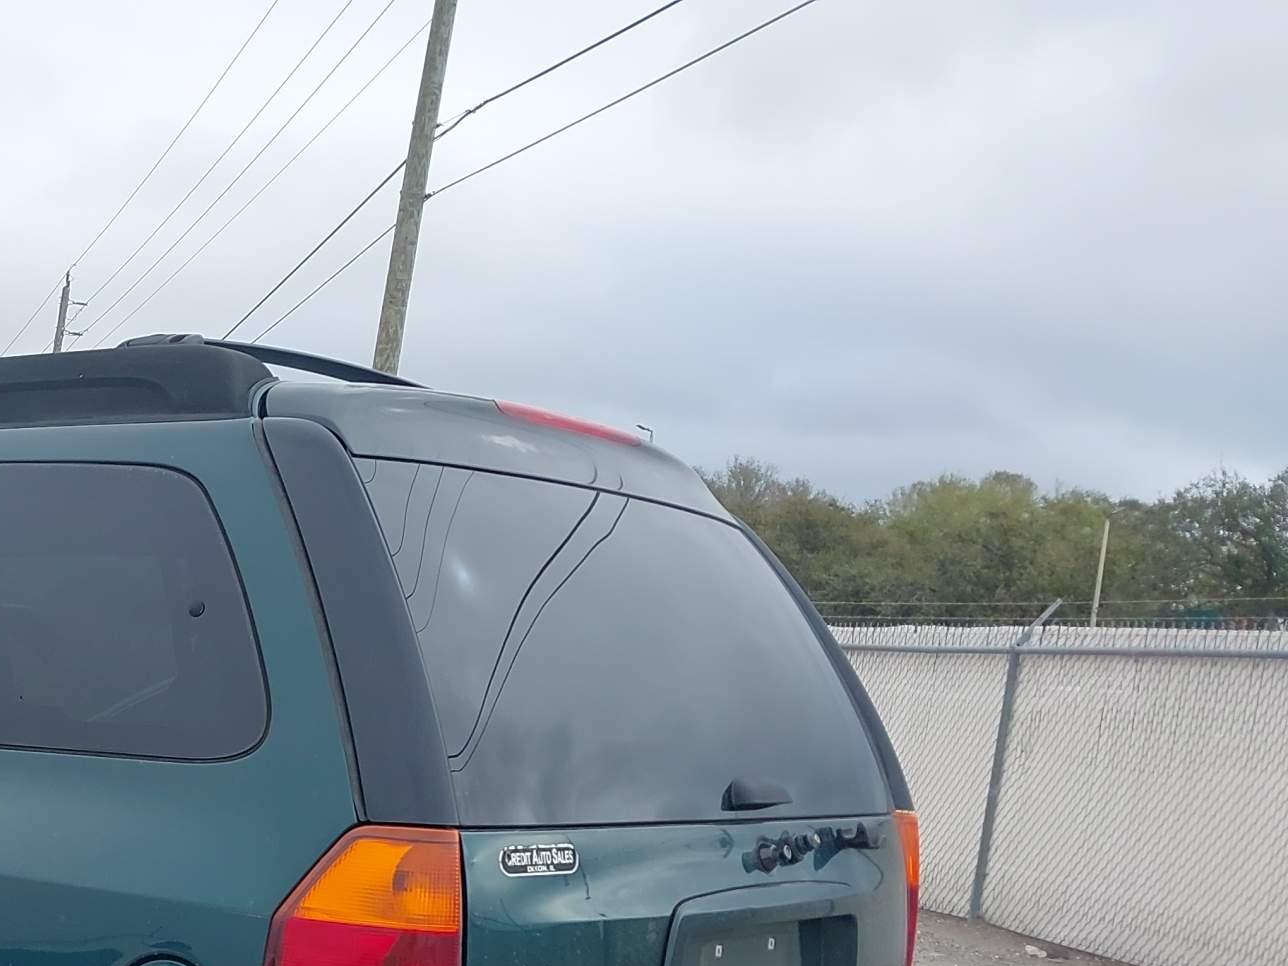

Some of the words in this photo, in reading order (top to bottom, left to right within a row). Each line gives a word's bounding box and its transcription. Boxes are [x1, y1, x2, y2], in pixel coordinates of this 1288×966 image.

[505, 850, 531, 866] CREDIT
[532, 849, 551, 865] AUTO
[552, 848, 573, 864] SALES
